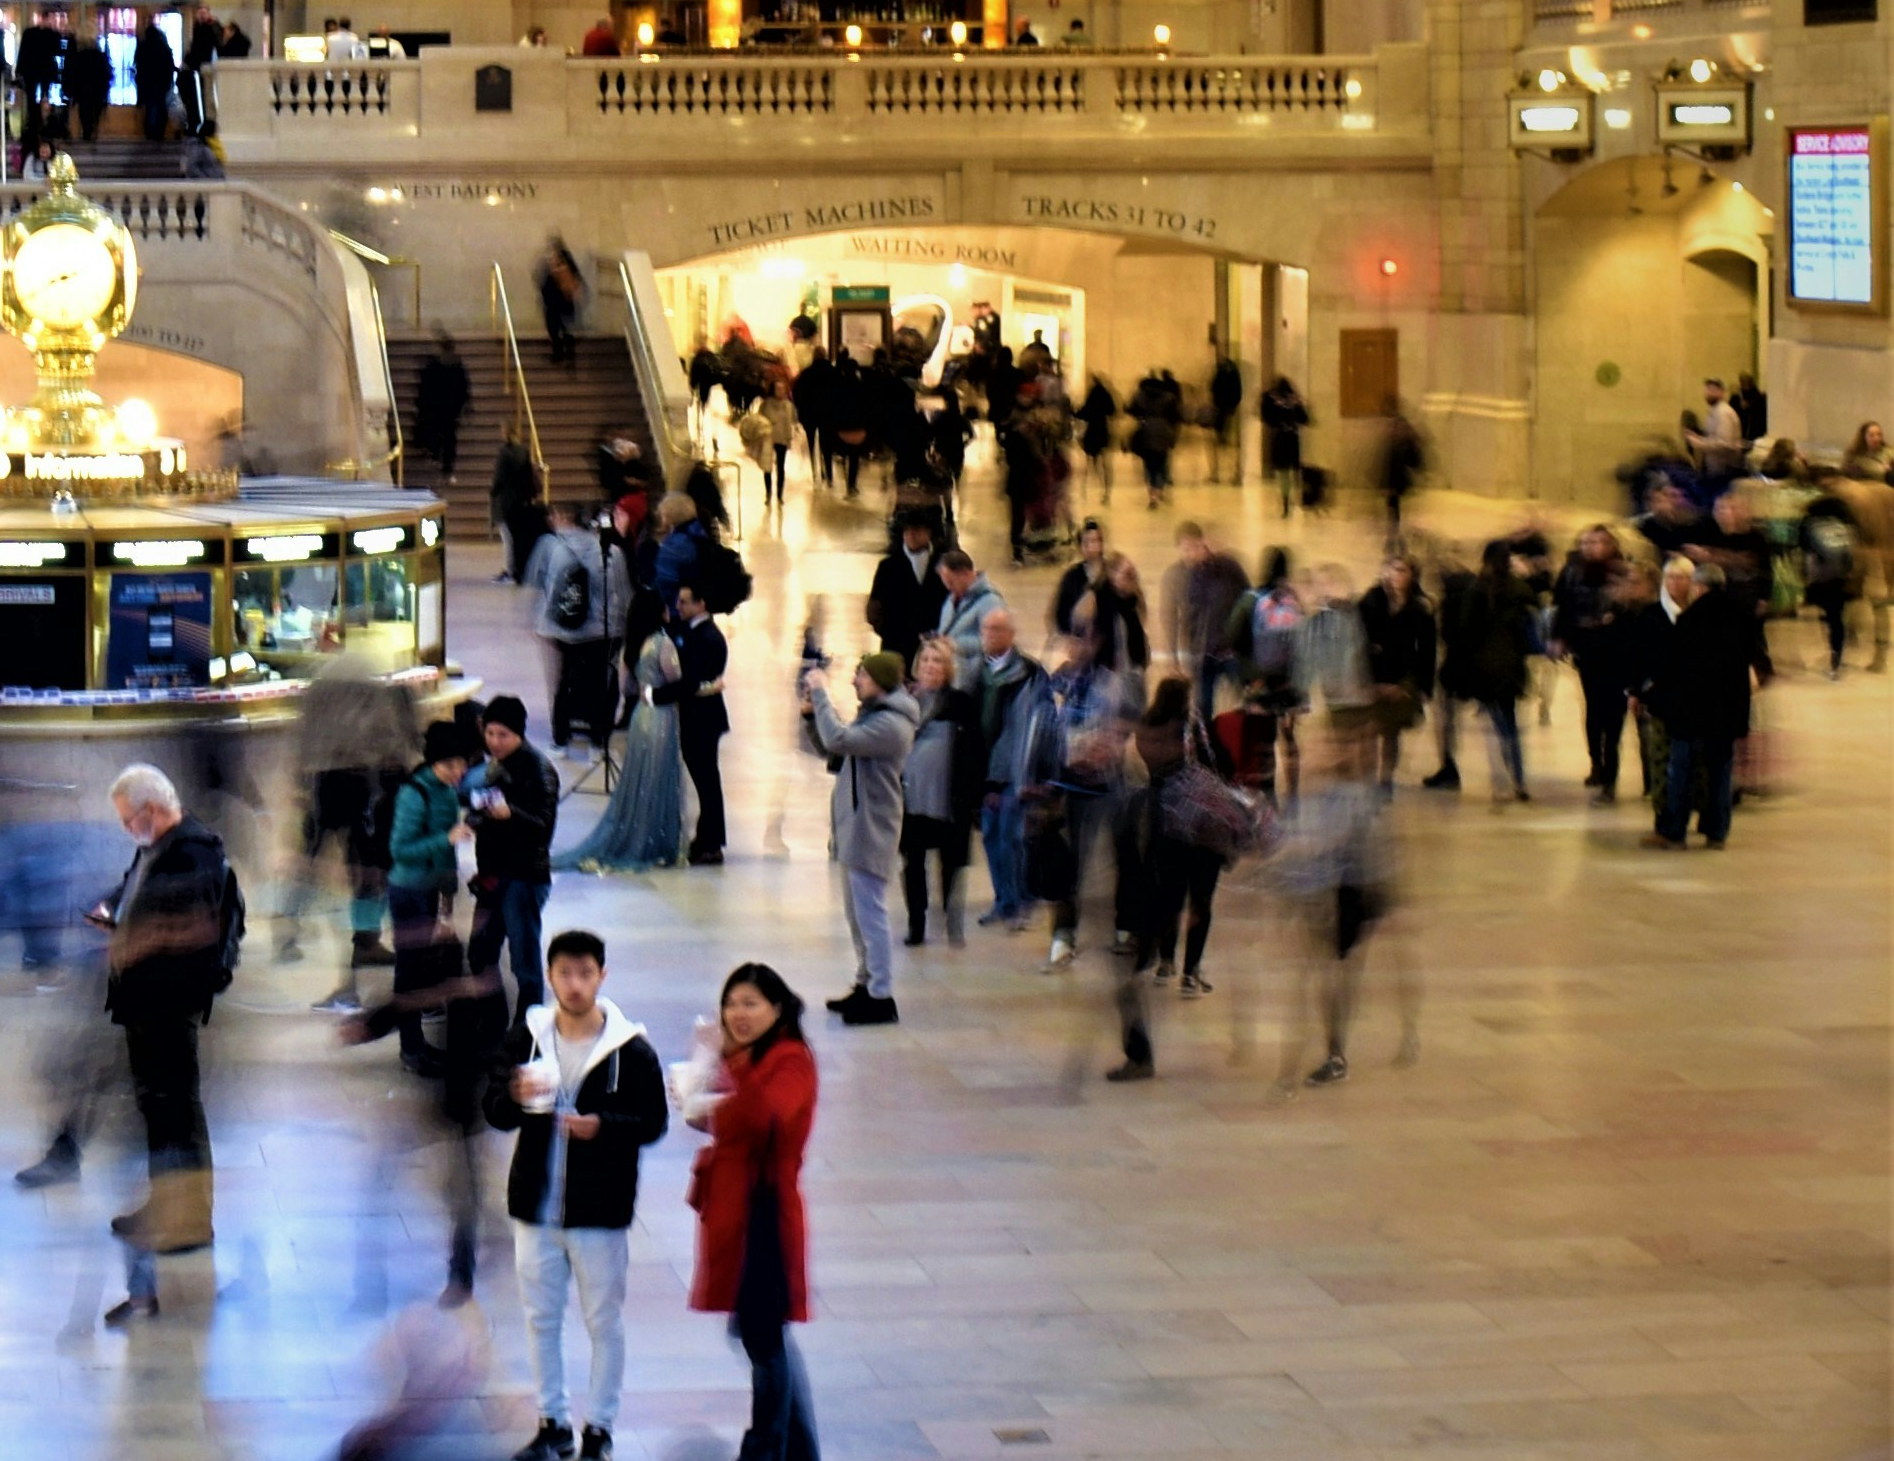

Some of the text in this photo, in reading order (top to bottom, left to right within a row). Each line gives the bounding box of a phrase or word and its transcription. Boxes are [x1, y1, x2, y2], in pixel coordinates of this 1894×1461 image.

[451, 183, 540, 199] BALCONY
[708, 196, 934, 244] TICKET MACHINES
[1022, 195, 1118, 221] TRACKS
[1153, 211, 1187, 231] TO
[1192, 218, 1217, 238] 42
[851, 237, 1017, 267] WAITING ROOM
